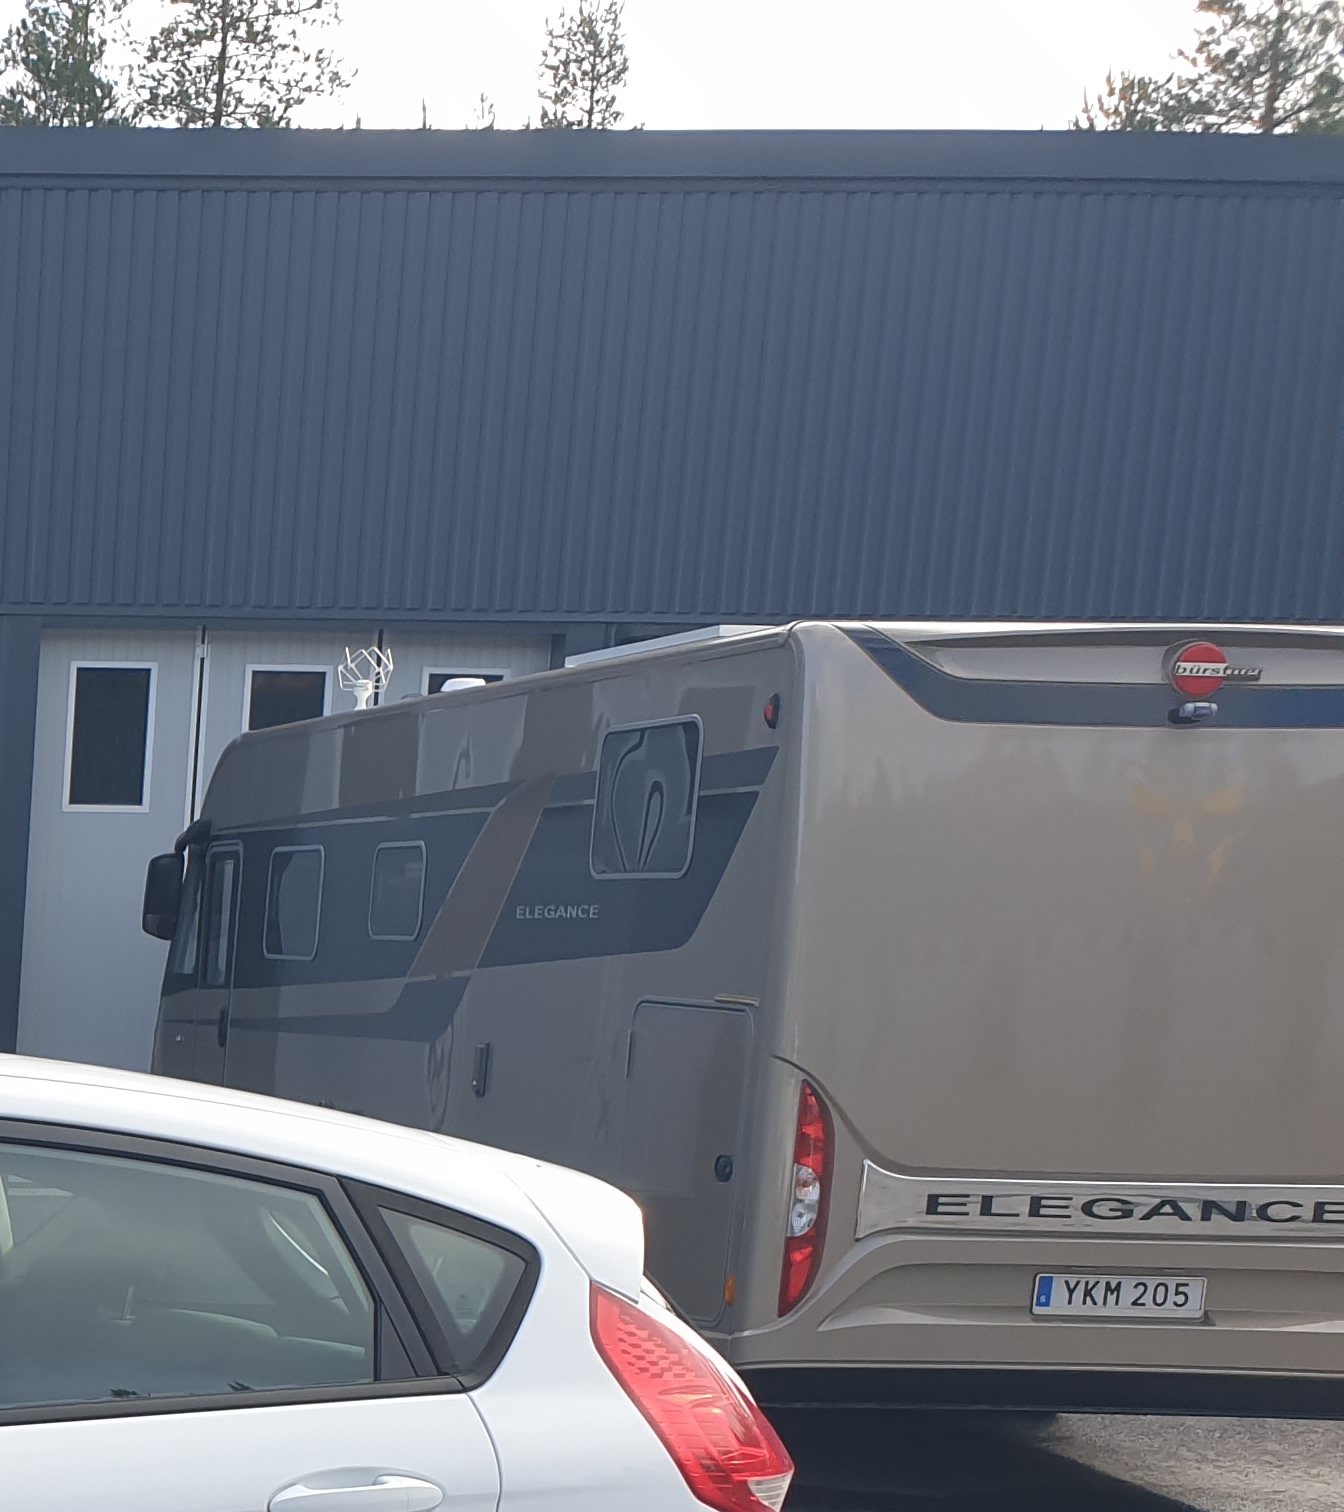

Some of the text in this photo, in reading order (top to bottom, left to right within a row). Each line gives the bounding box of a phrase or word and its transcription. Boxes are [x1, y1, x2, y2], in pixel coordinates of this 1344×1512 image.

[515, 904, 600, 920] ELEGANCE
[925, 1193, 1344, 1224] ELEGANCE
[1064, 1279, 1191, 1308] YKM 205
